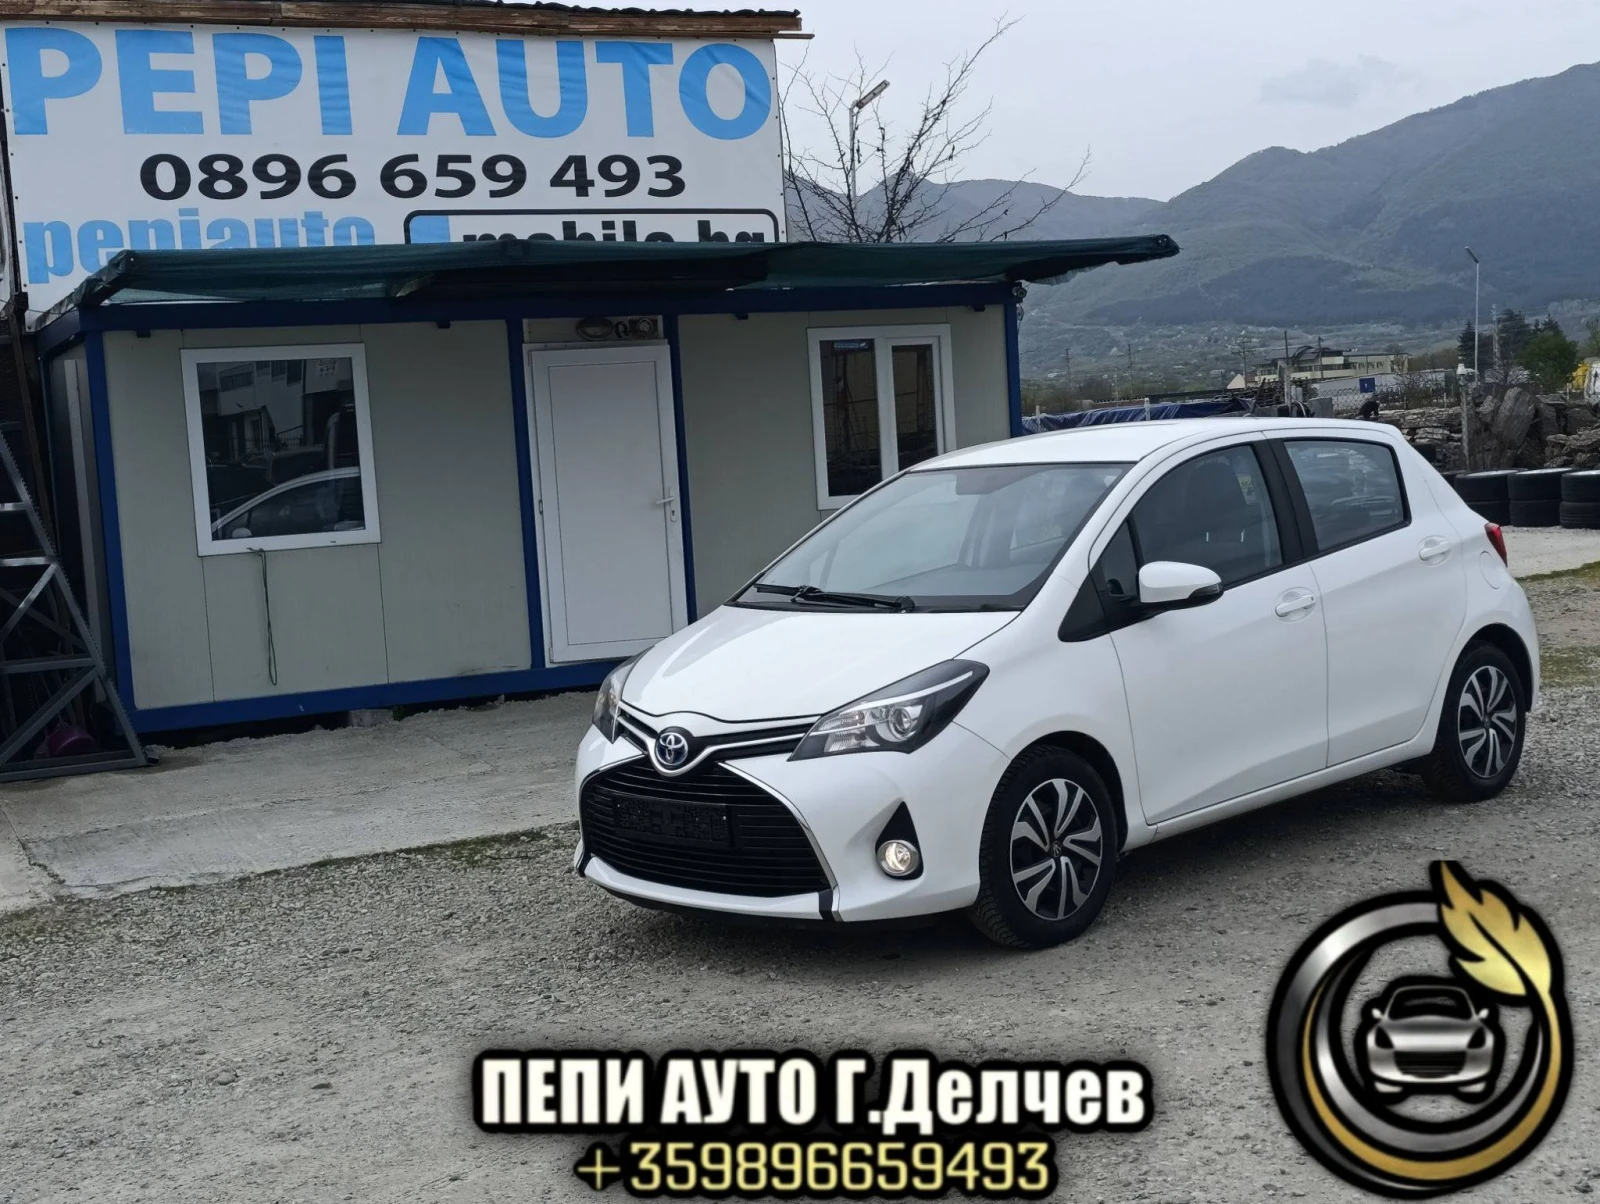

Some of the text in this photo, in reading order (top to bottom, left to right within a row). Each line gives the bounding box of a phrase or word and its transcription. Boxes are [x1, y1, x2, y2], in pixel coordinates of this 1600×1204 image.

[4, 27, 771, 140] PEPI AUTO
[140, 153, 686, 201] 0896 659 493
